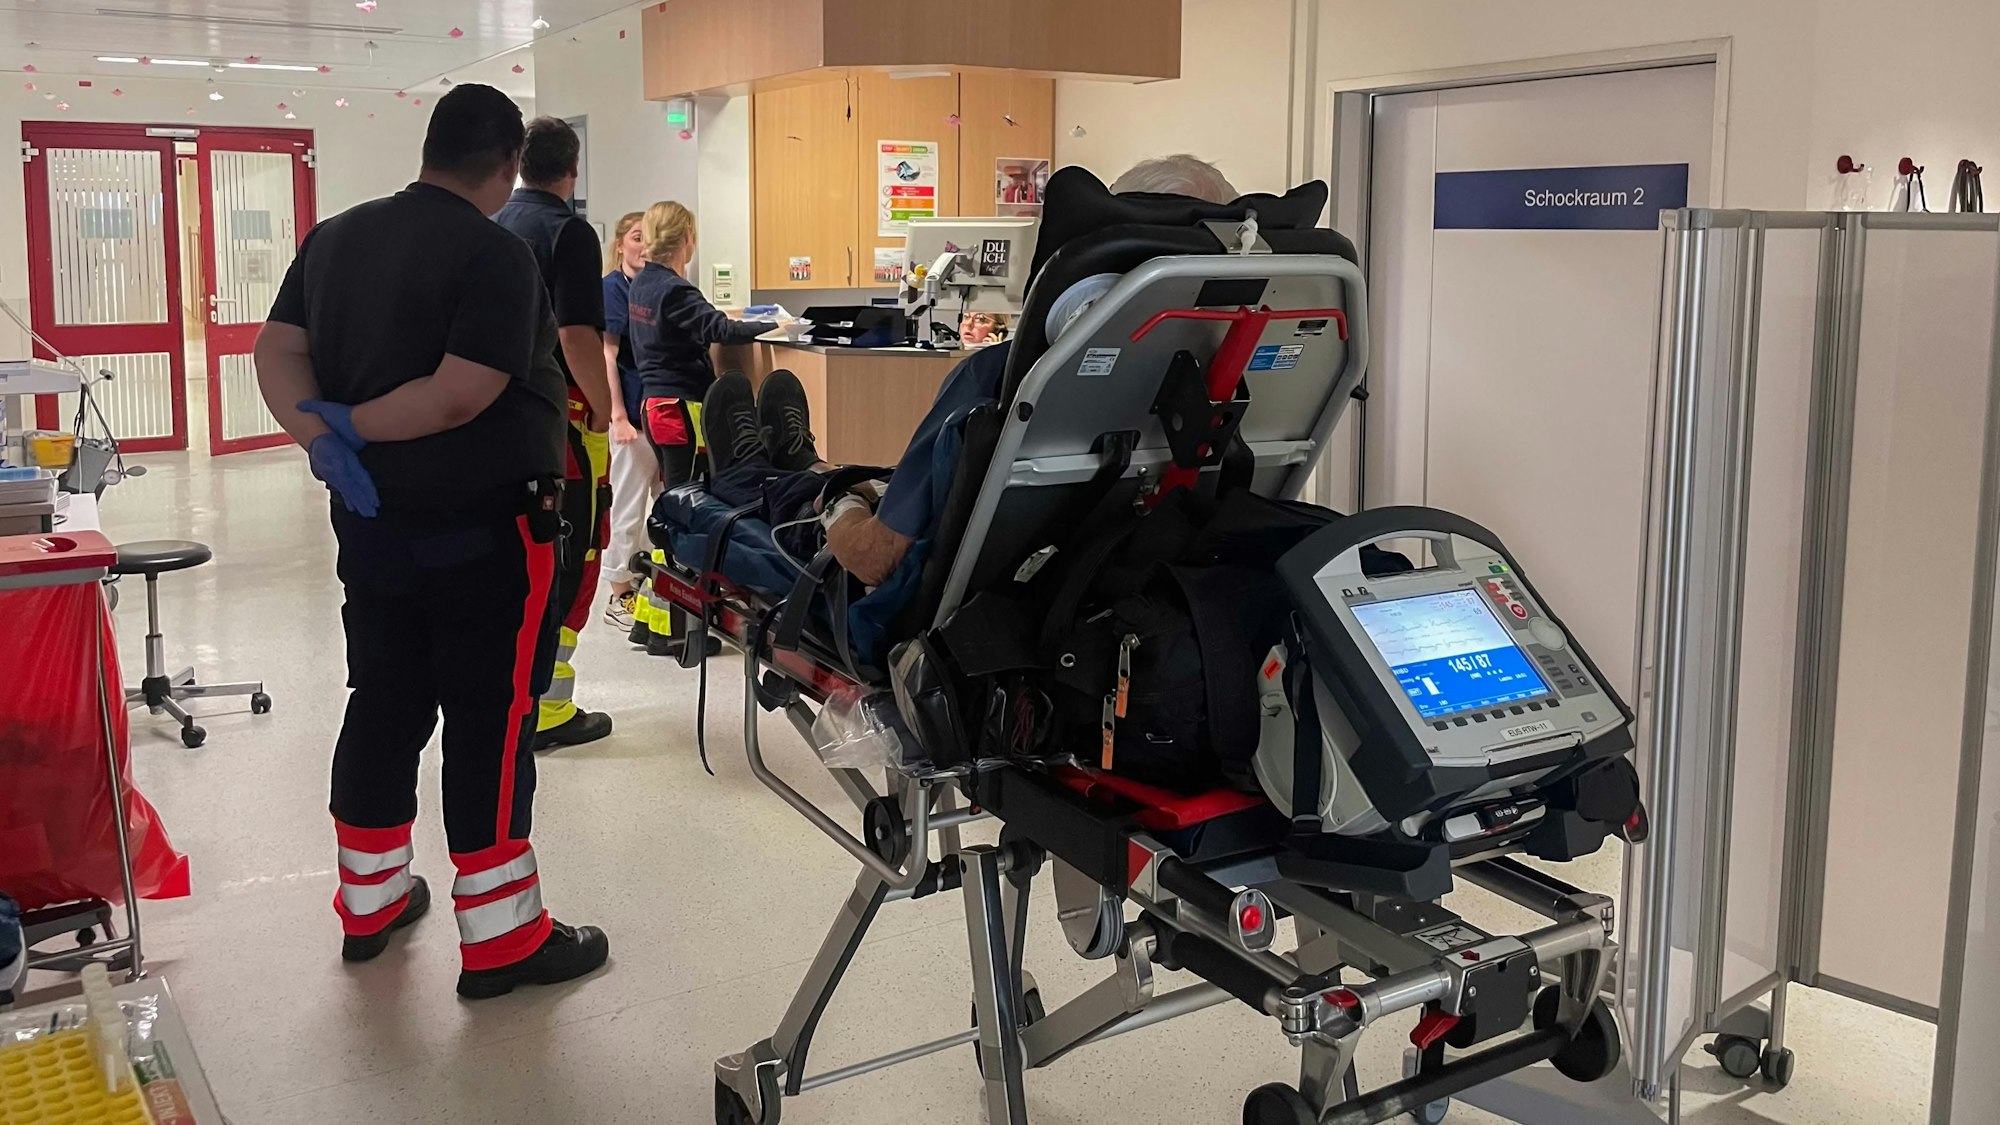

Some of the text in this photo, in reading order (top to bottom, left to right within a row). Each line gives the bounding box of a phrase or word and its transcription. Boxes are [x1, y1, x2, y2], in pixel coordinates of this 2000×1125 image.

[1525, 187, 1645, 207] Schockraum 2
[986, 241, 1006, 253] DU.
[983, 252, 1006, 263] ICH.
[1507, 722, 1548, 737] EUS RTW-11
